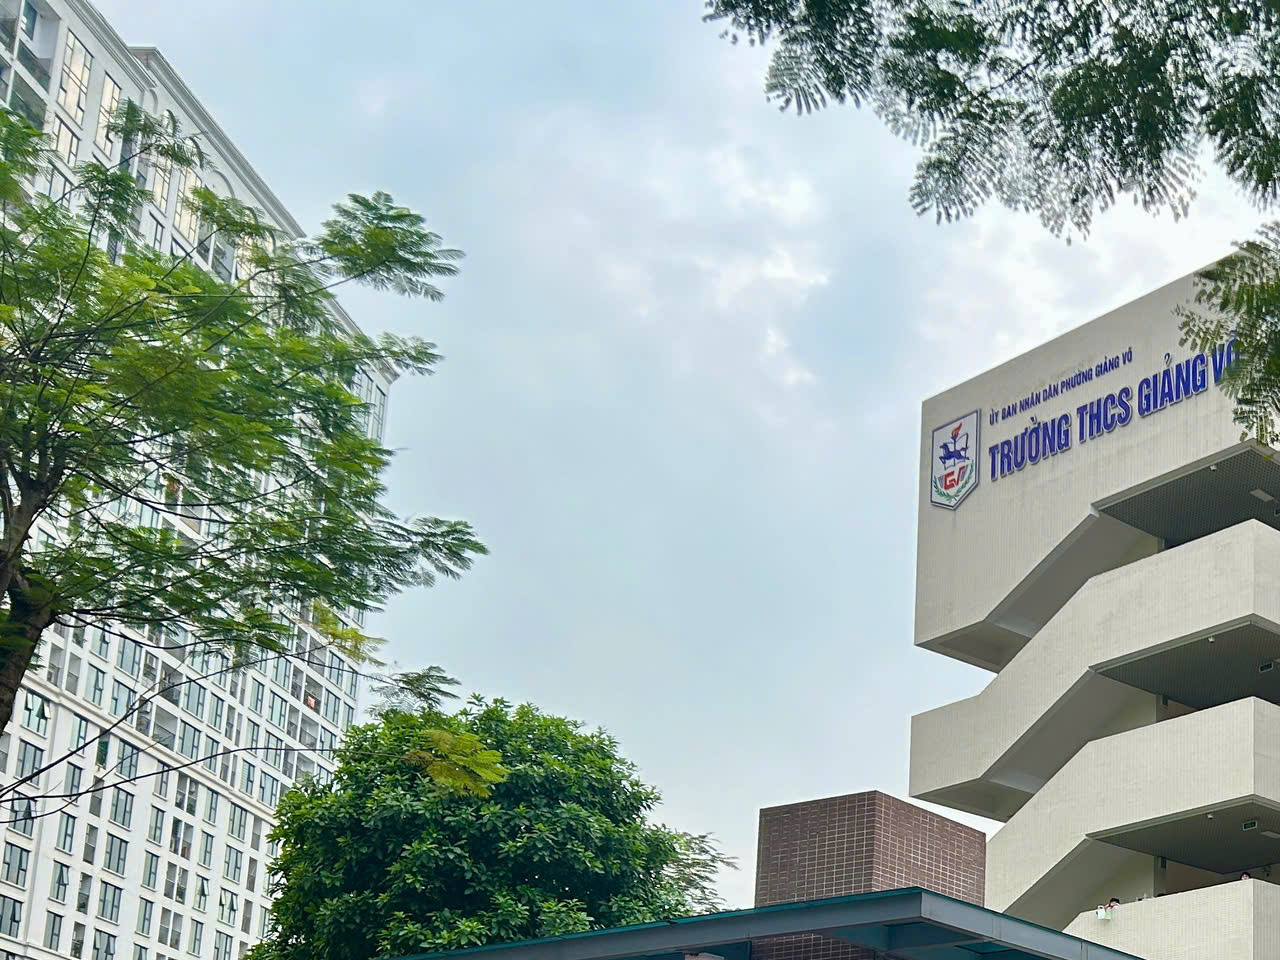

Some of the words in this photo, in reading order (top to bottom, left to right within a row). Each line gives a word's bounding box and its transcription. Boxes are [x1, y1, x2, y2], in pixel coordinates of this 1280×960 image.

[989, 413, 1072, 481] TRƯỜNG
[1077, 386, 1132, 443] THCS
[1138, 352, 1208, 417] GIẢNG
[1001, 403, 1017, 420] BAN
[1019, 392, 1041, 412] NHÂN
[1042, 384, 1059, 402] DÂN
[1060, 369, 1093, 393] PHƯỜNG
[1095, 355, 1120, 378] GIẢNG
[1122, 346, 1133, 365] VÕ
